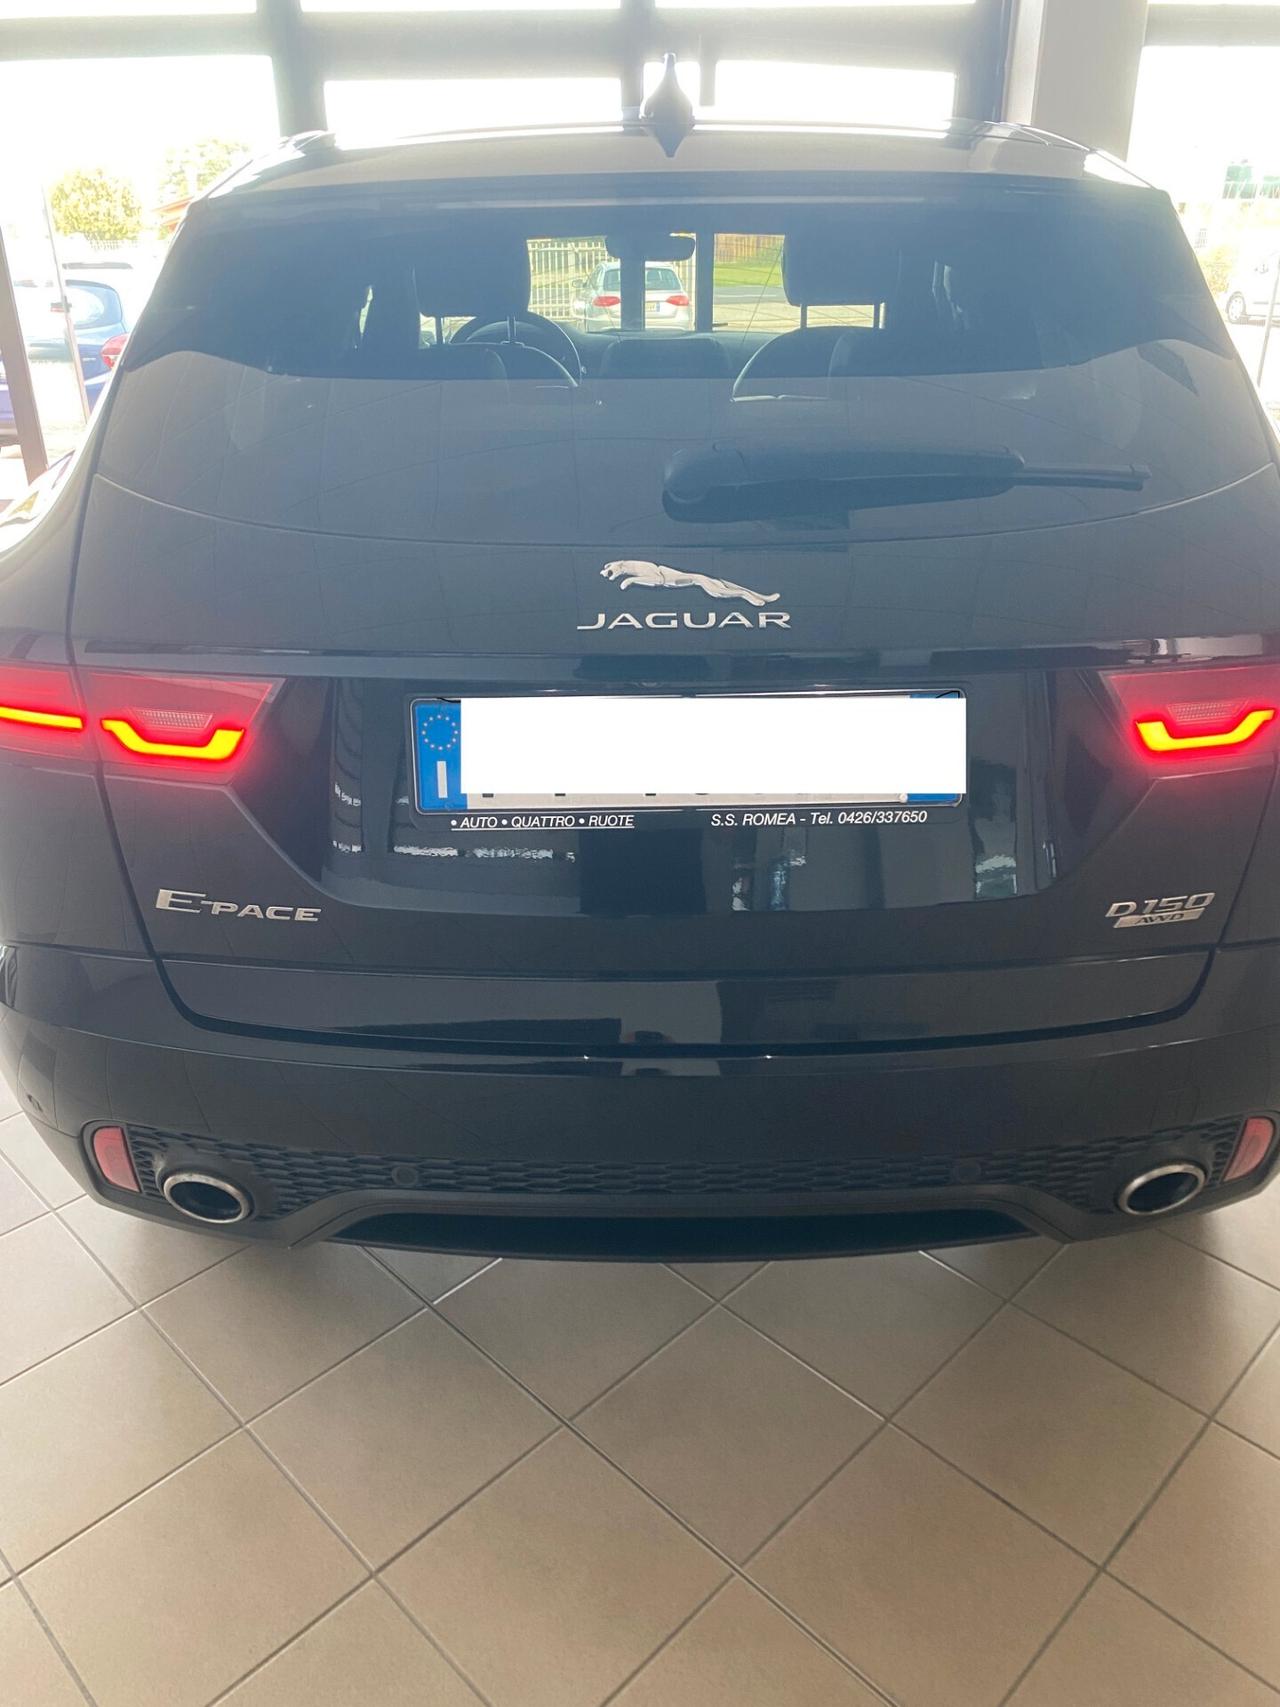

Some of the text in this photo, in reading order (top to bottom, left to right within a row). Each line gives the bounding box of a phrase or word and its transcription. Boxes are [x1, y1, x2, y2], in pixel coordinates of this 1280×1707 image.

[577, 612, 791, 630] JAGUAR
[460, 814, 635, 829] AUTO QUATTRO RUOTE
[711, 813, 738, 826] S.S.
[742, 812, 796, 826] ROMEA
[810, 812, 834, 825] Tel.
[838, 810, 928, 824] 0426/337650
[155, 888, 322, 922] E-PACE
